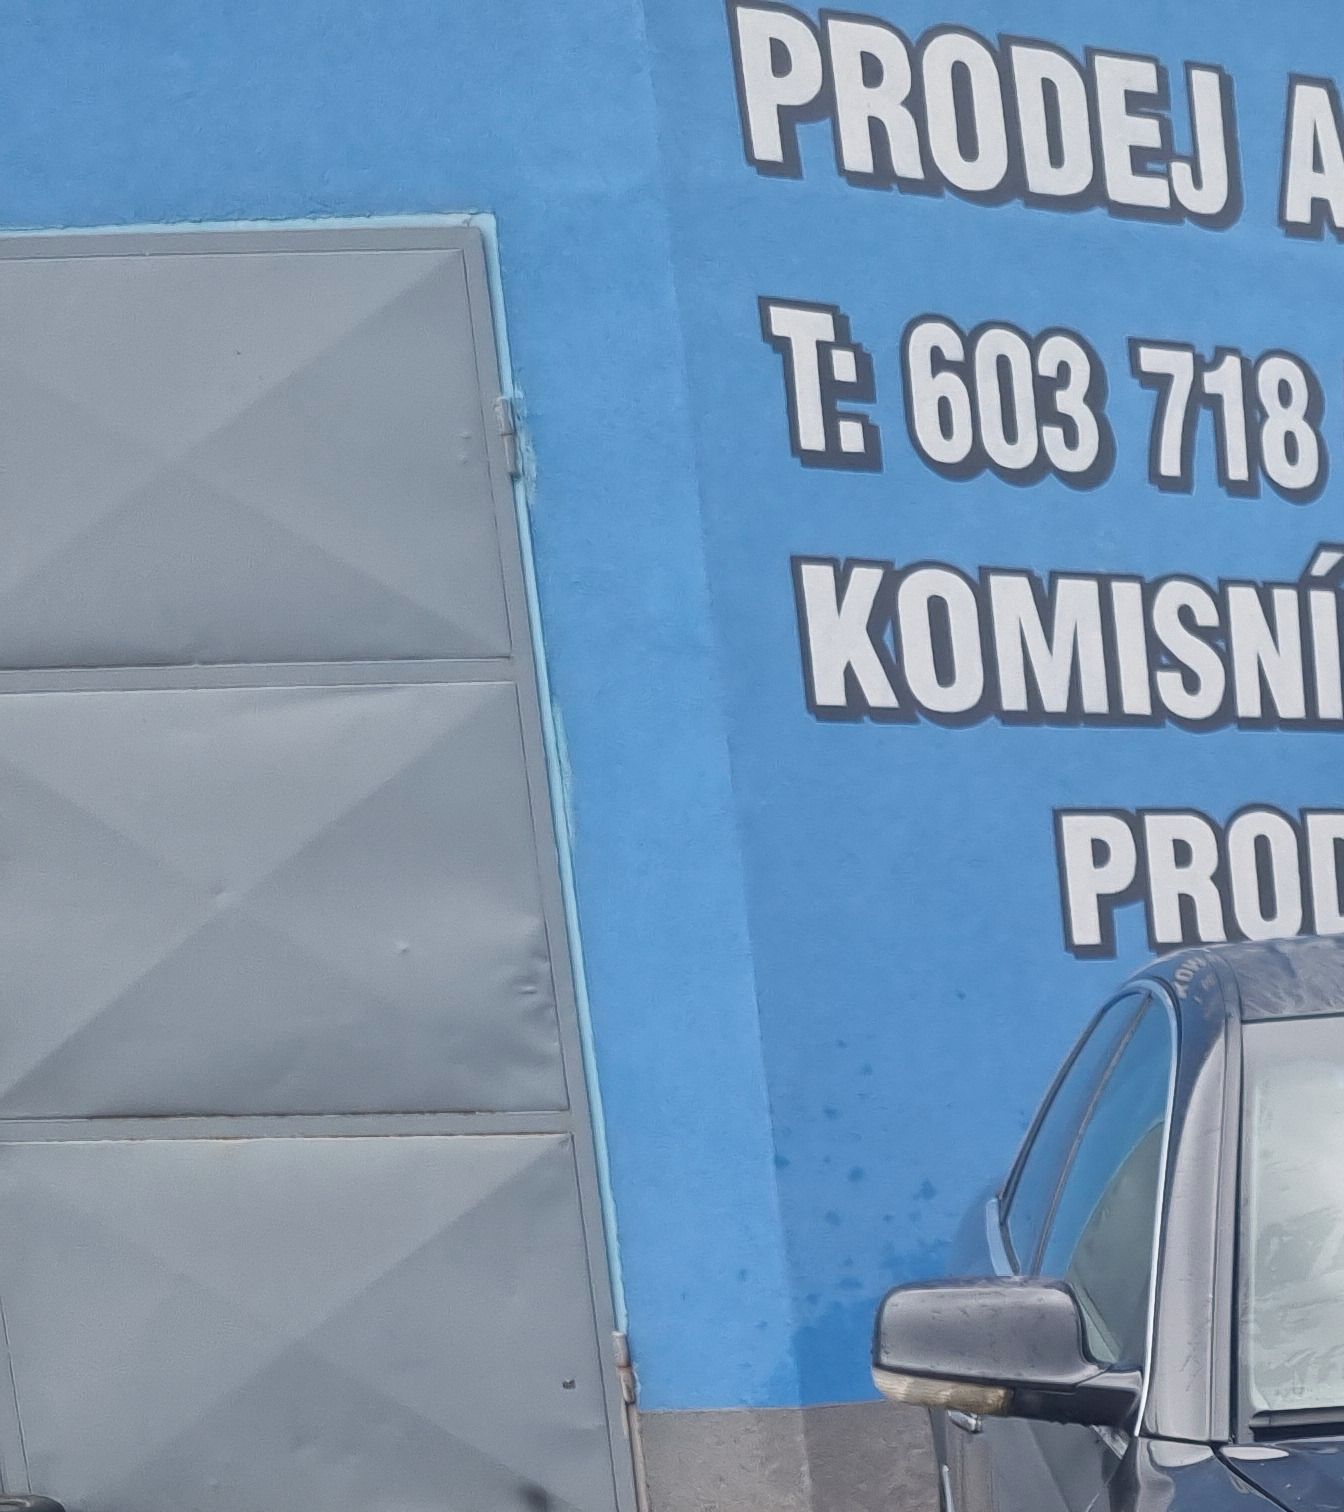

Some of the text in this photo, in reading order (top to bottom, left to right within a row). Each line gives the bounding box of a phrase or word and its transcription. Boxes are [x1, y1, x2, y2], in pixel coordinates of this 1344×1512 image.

[730, 2, 1240, 226] PRODEJ
[766, 300, 874, 462] T:
[906, 318, 1106, 480] 603
[1136, 340, 1324, 496] 718
